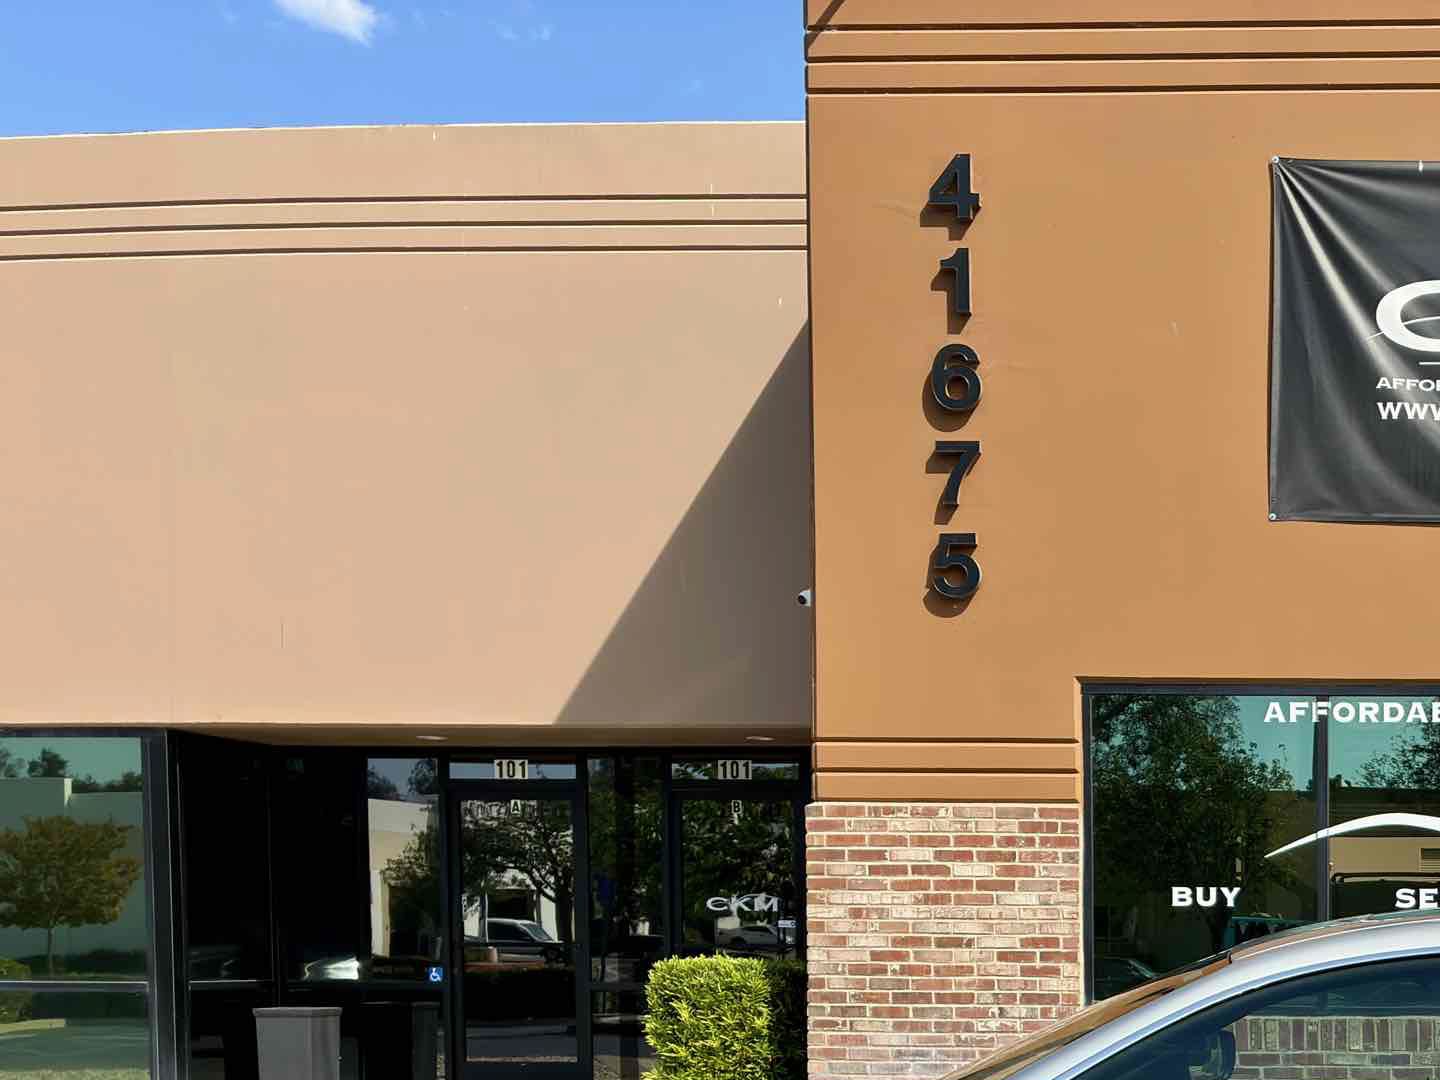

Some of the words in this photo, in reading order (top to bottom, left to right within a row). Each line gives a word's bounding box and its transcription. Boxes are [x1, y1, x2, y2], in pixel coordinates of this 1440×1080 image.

[927, 153, 983, 599] 41675
[495, 760, 528, 779] 101
[718, 761, 752, 779] 101
[706, 896, 779, 912] CKM
[1171, 886, 1241, 907] BUY
